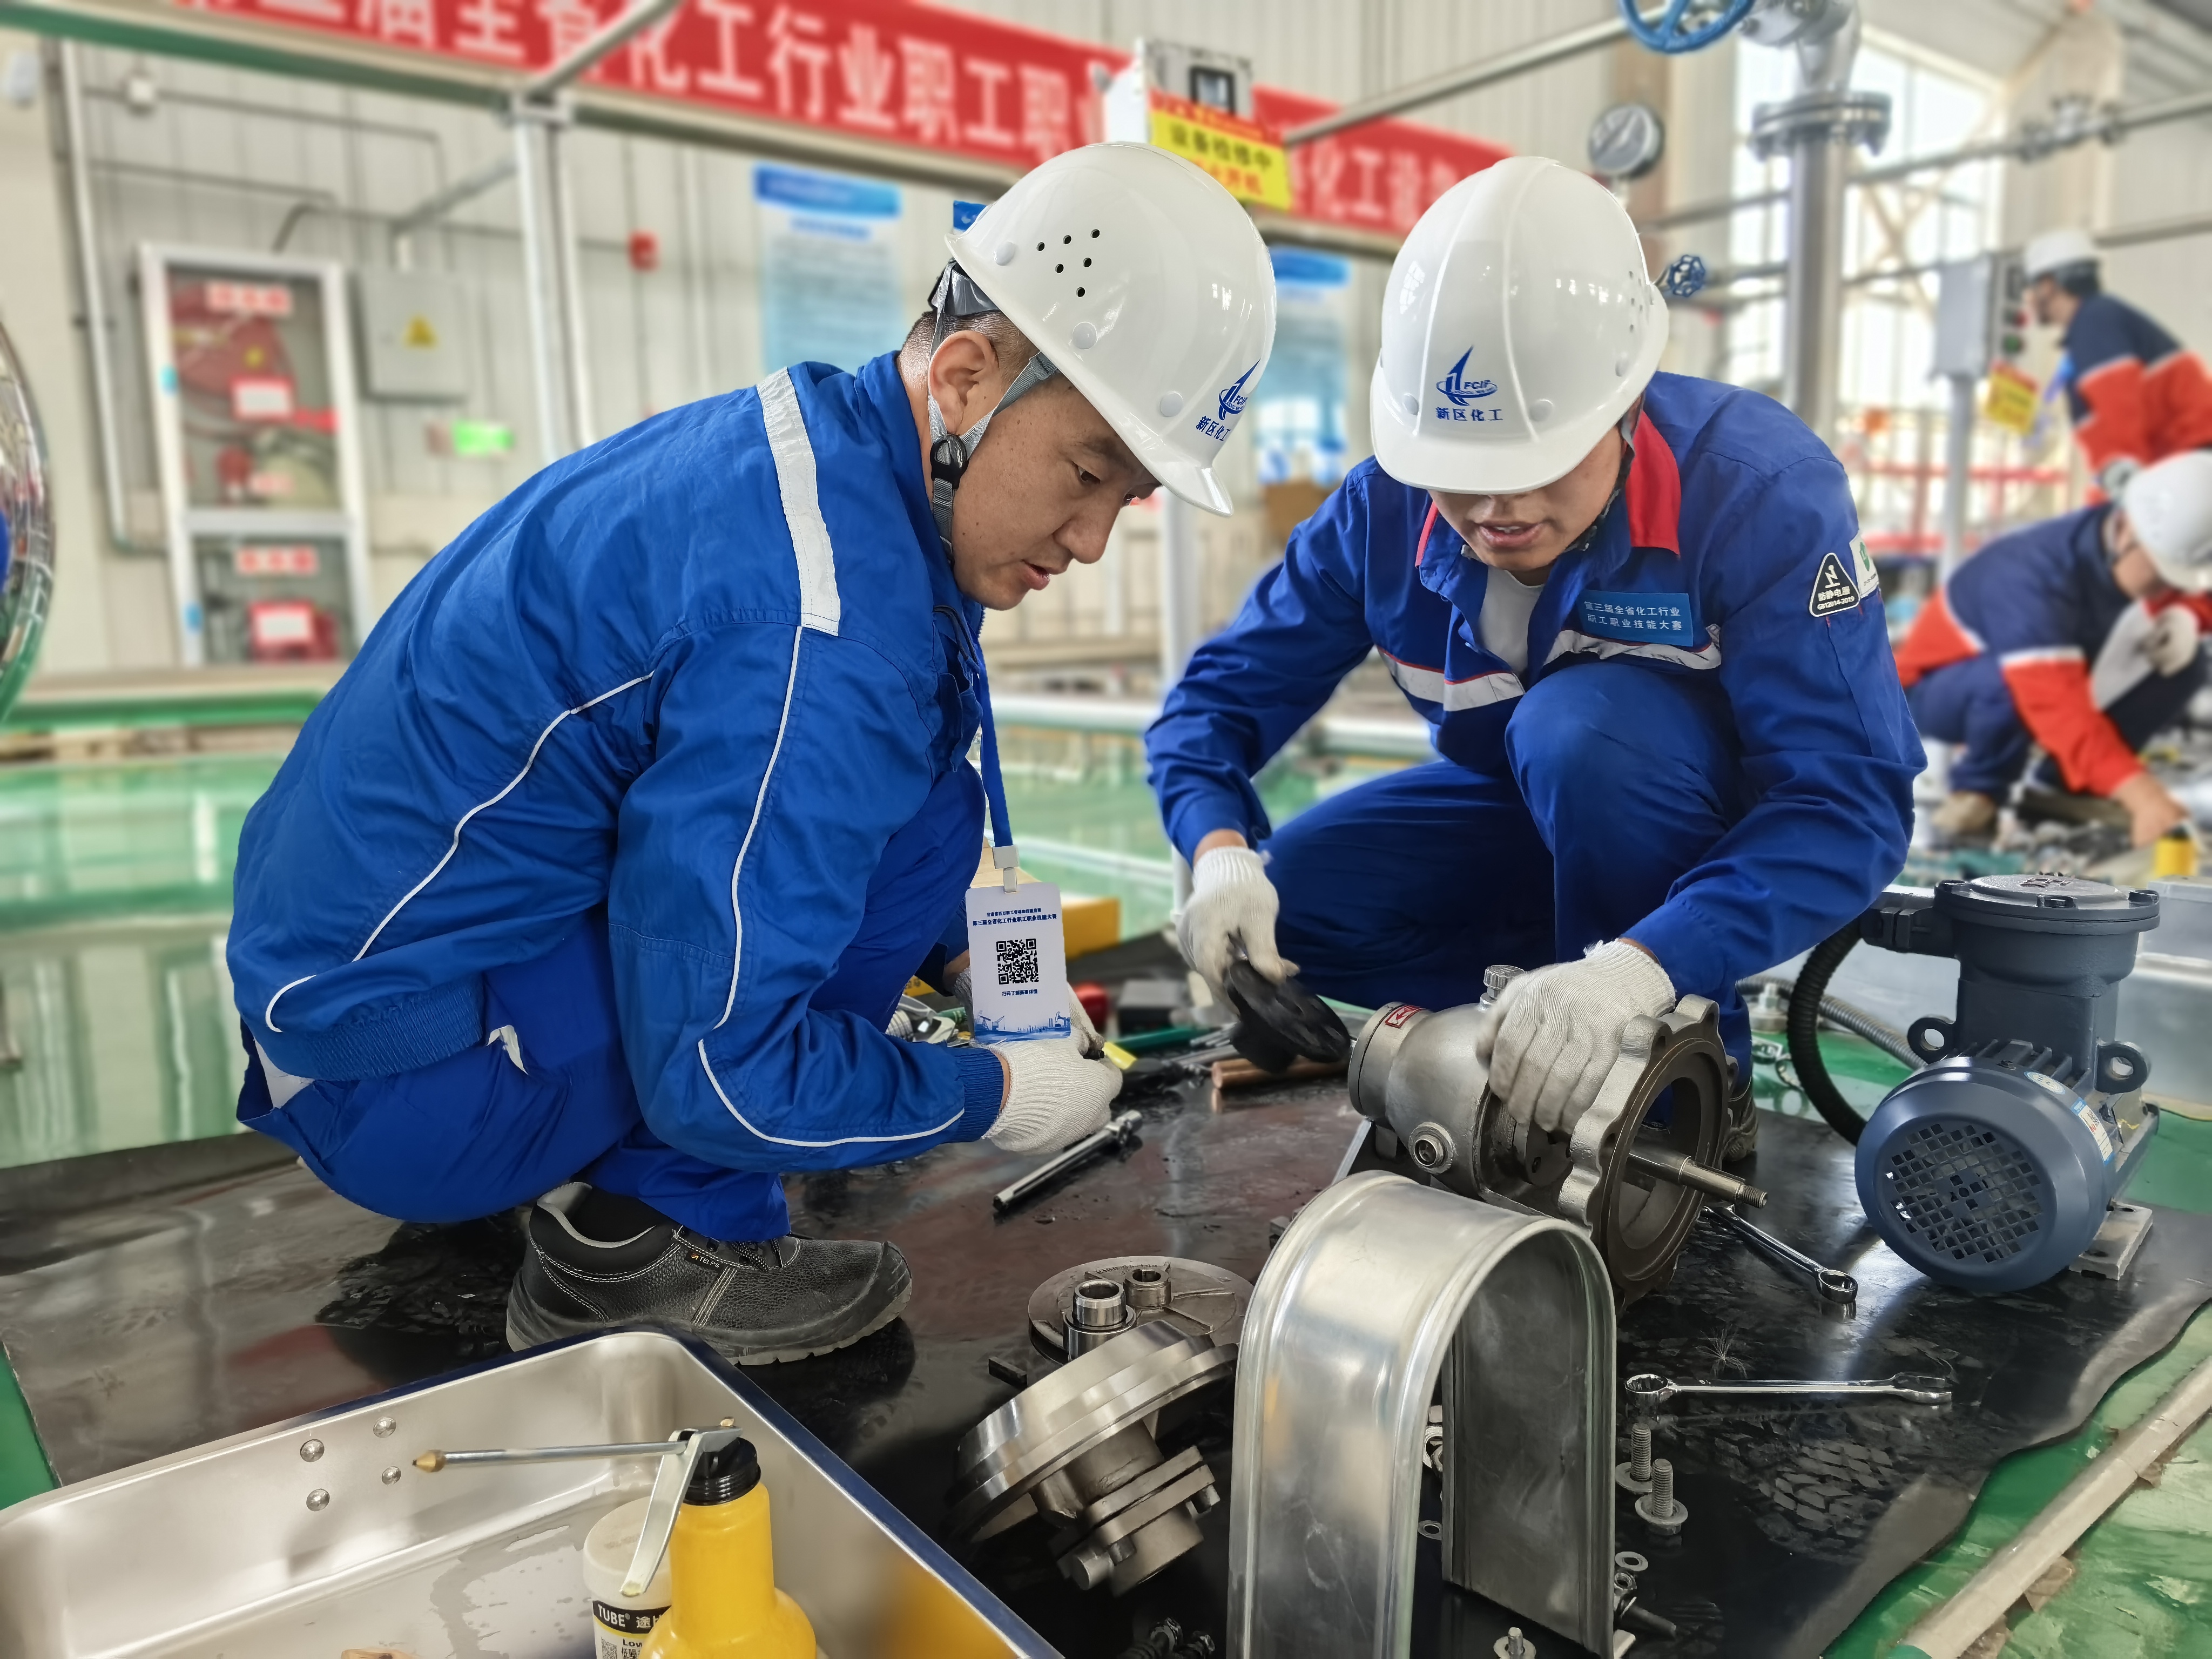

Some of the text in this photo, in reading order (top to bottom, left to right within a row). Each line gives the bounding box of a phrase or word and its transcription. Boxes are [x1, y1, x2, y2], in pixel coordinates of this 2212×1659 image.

[1464, 379, 1491, 390] FCIF
[1435, 407, 1503, 421] 新区化工
[1196, 415, 1231, 441] 新区化工
[1584, 601, 1681, 617] 第三届全省化工行业
[1587, 614, 1683, 631] 职工职业技能大赛
[699, 1256, 720, 1268] TELPS
